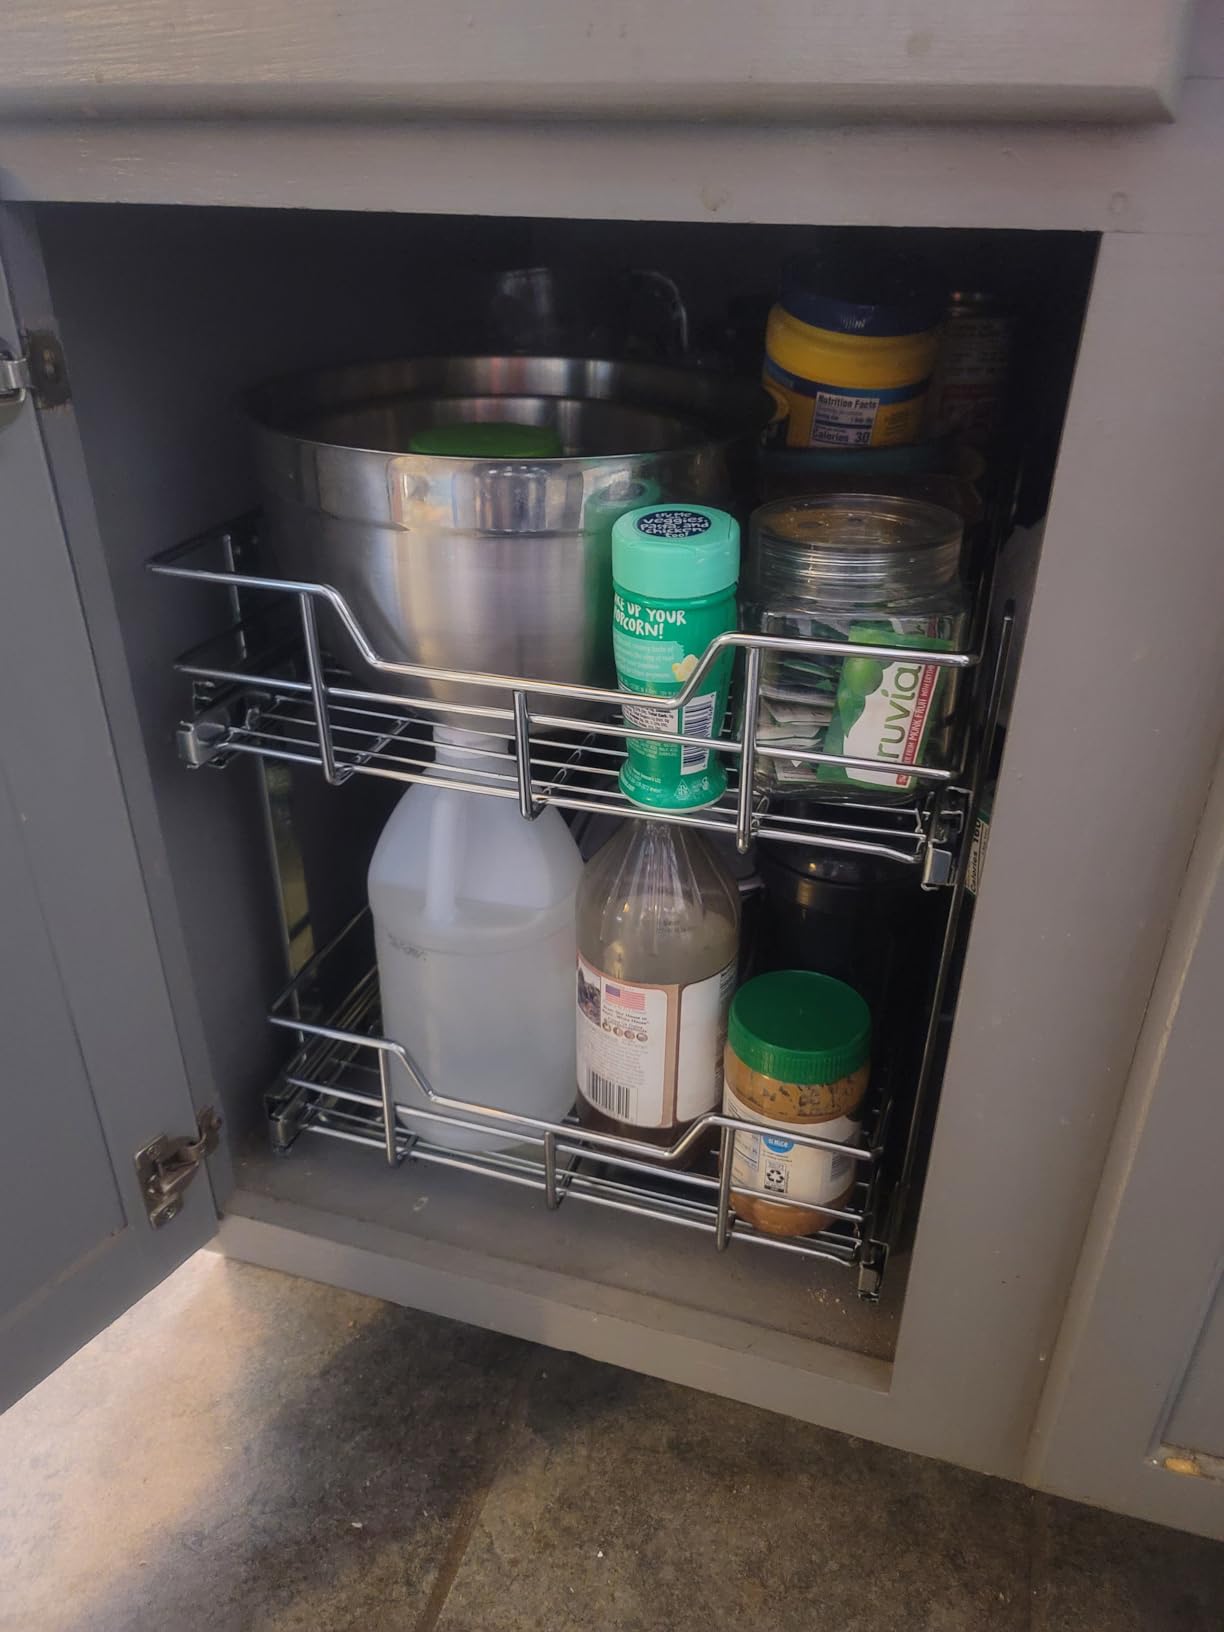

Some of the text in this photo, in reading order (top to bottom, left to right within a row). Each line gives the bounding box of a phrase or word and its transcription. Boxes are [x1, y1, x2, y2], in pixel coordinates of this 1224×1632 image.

[818, 394, 877, 409] Nutrition Facts
[814, 429, 870, 443] Calories 30
[683, 521, 709, 529] and
[626, 602, 642, 617] UP
[645, 608, 687, 626] YOUR
[877, 665, 922, 763] ruvia
[913, 698, 927, 719] FRUIT
[908, 718, 922, 741] MONK
[969, 851, 979, 893] Calories
